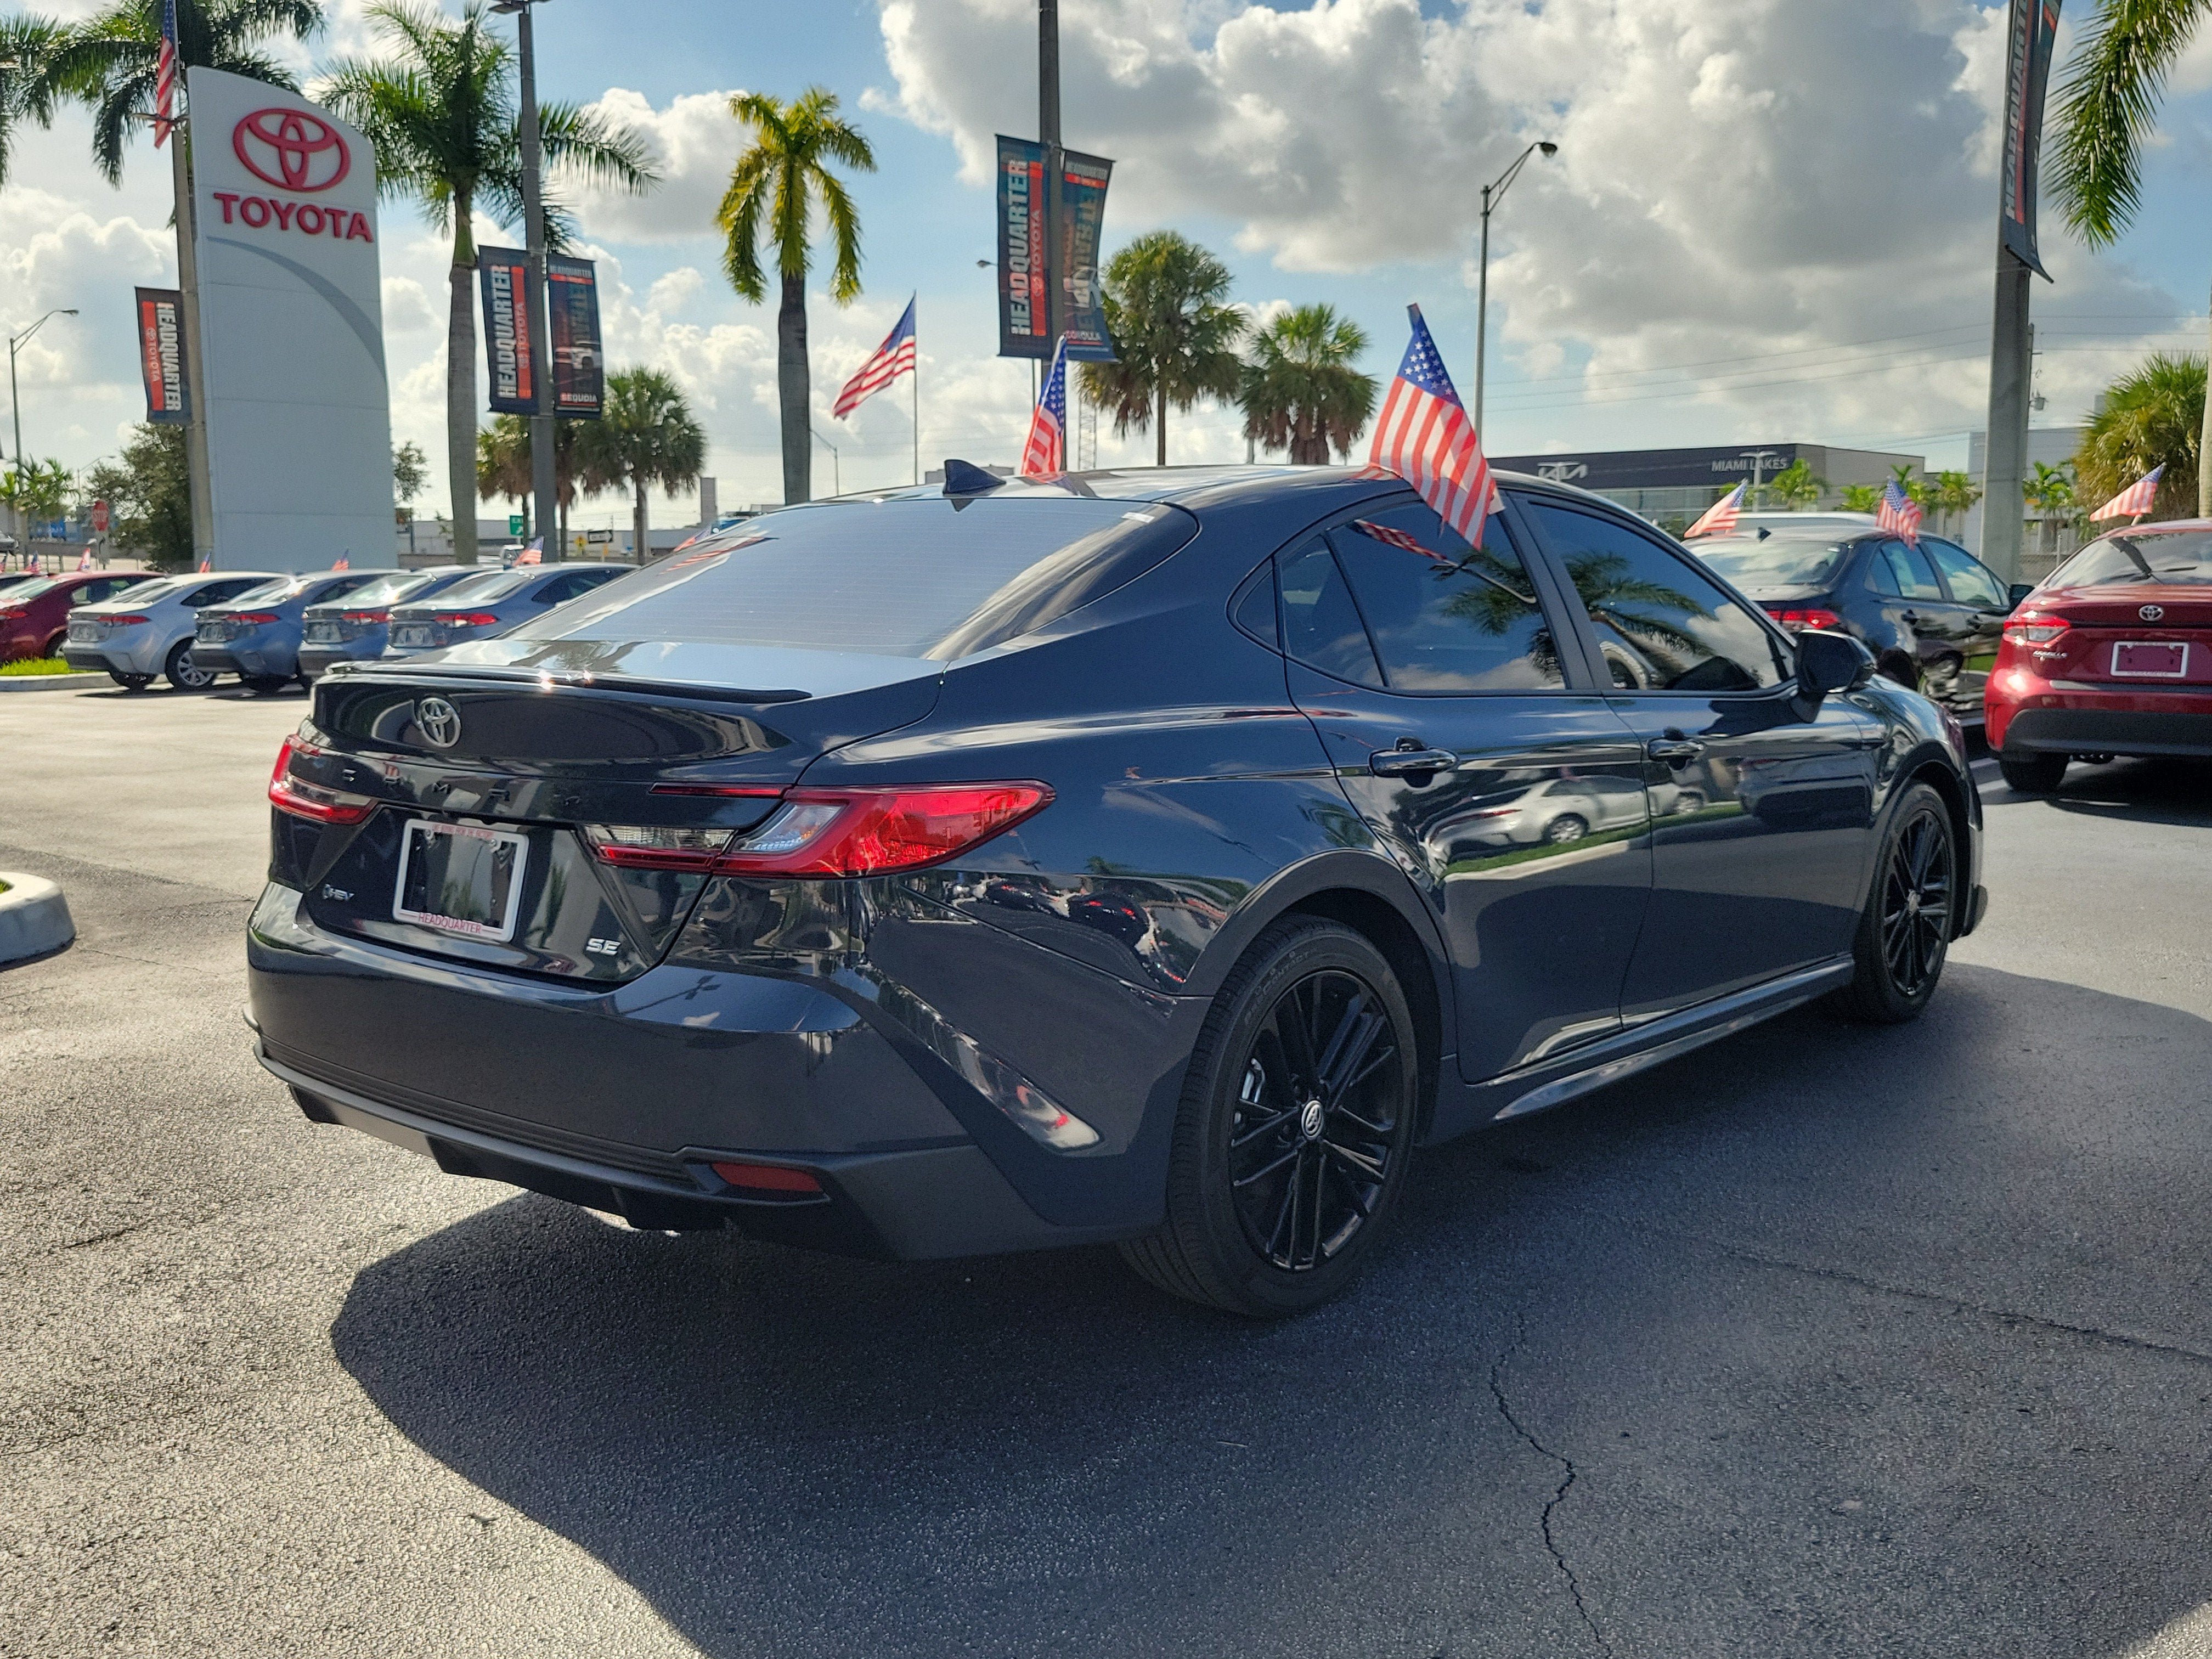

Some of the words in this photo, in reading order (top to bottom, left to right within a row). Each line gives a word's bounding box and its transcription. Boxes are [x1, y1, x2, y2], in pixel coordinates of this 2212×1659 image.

[213, 193, 374, 242] TOYOTA
[1007, 159, 1031, 336] HEADQUARTER
[1031, 211, 1041, 273] TOYOTA
[490, 266, 517, 398] HEADQUARTER
[516, 303, 527, 351] TOYOTA
[149, 342, 160, 382] TOYOTA
[156, 302, 182, 411] HEADQUARTER
[560, 392, 597, 403] SEQUOIA
[1712, 460, 1748, 472] MIAMI
[93, 510, 109, 522] STOP
[419, 913, 481, 934] HEADQUARTER
[586, 938, 621, 955] SE
